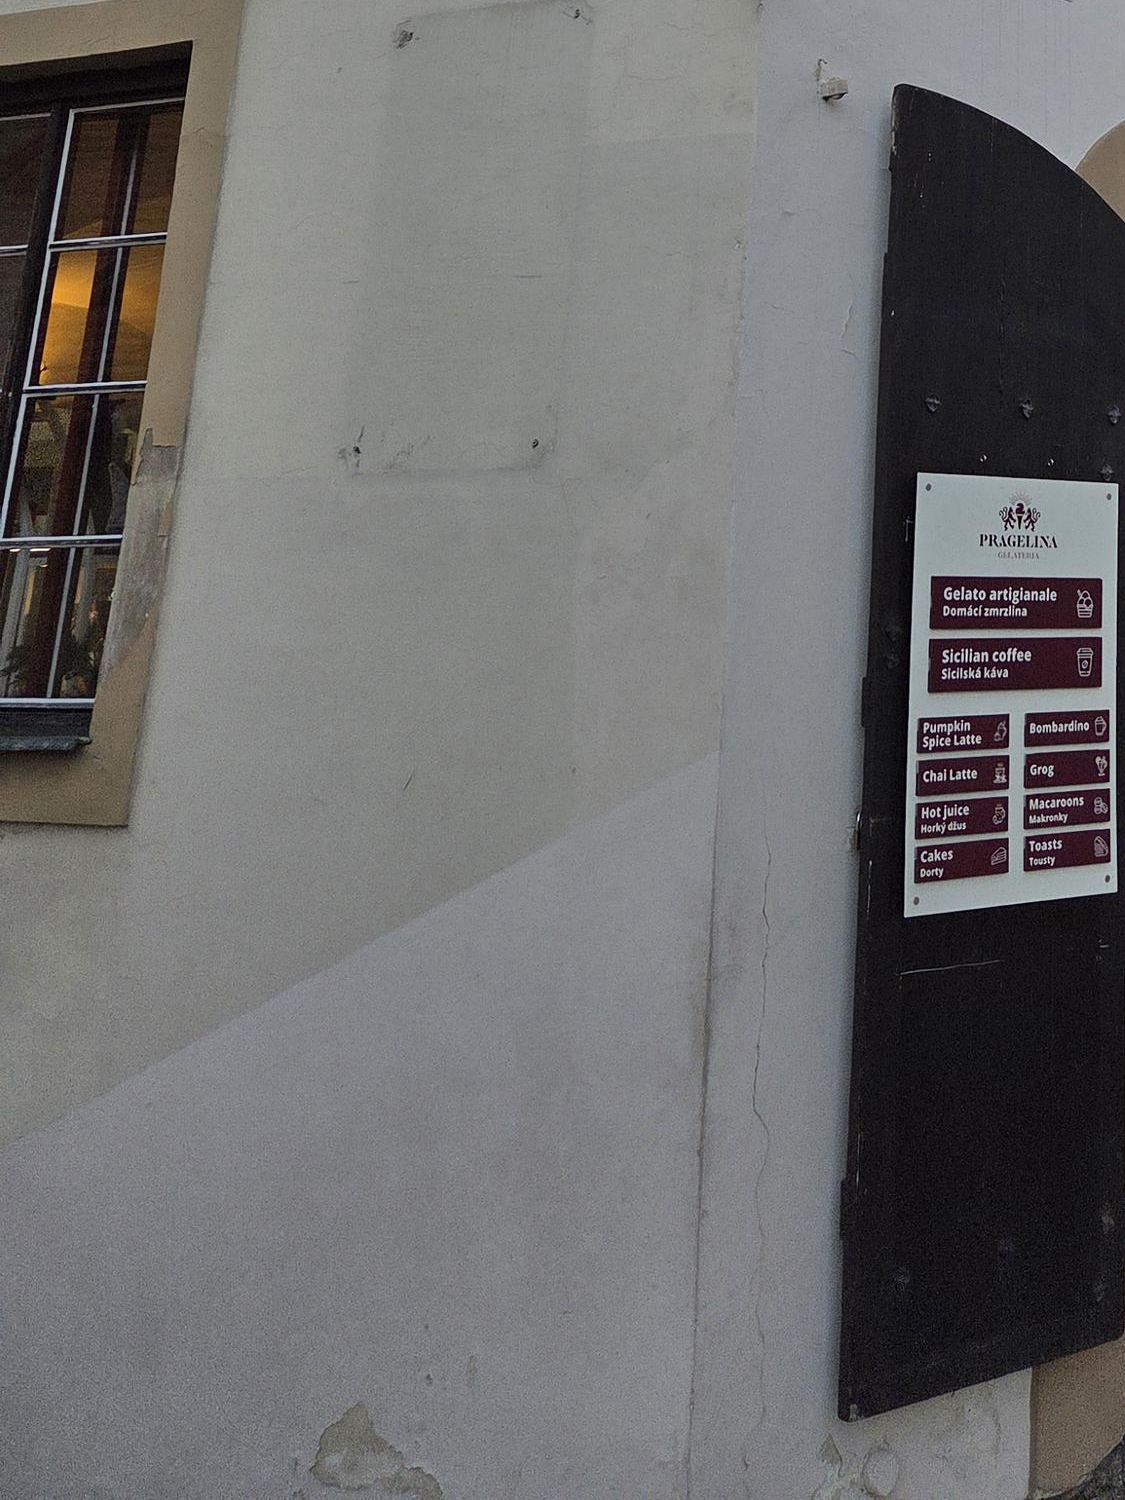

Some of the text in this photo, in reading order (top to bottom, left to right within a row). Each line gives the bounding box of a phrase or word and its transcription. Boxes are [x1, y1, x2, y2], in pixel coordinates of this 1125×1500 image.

[979, 533, 1058, 549] PRAGELINA
[943, 586, 1057, 605] Gelato artigianale
[943, 604, 1028, 617] Domácí zmrzlina
[941, 647, 1032, 663] Sicilian coffee
[941, 667, 1009, 680] Sicilská káva
[922, 719, 971, 734] Pumpkin
[1029, 720, 1090, 734] Bombardino
[922, 734, 982, 751] Spice Latte
[922, 768, 978, 783] Chai Latte
[1030, 763, 1054, 778] Grog
[1029, 795, 1084, 811] Macaroons
[921, 804, 970, 819] Hot juice
[1029, 812, 1069, 825] Makronky
[920, 821, 967, 834] Horký džus
[1029, 838, 1063, 852] Toasts
[920, 849, 954, 863] Cakes
[1029, 855, 1056, 867] Tousty
[920, 867, 944, 878] Dorty
